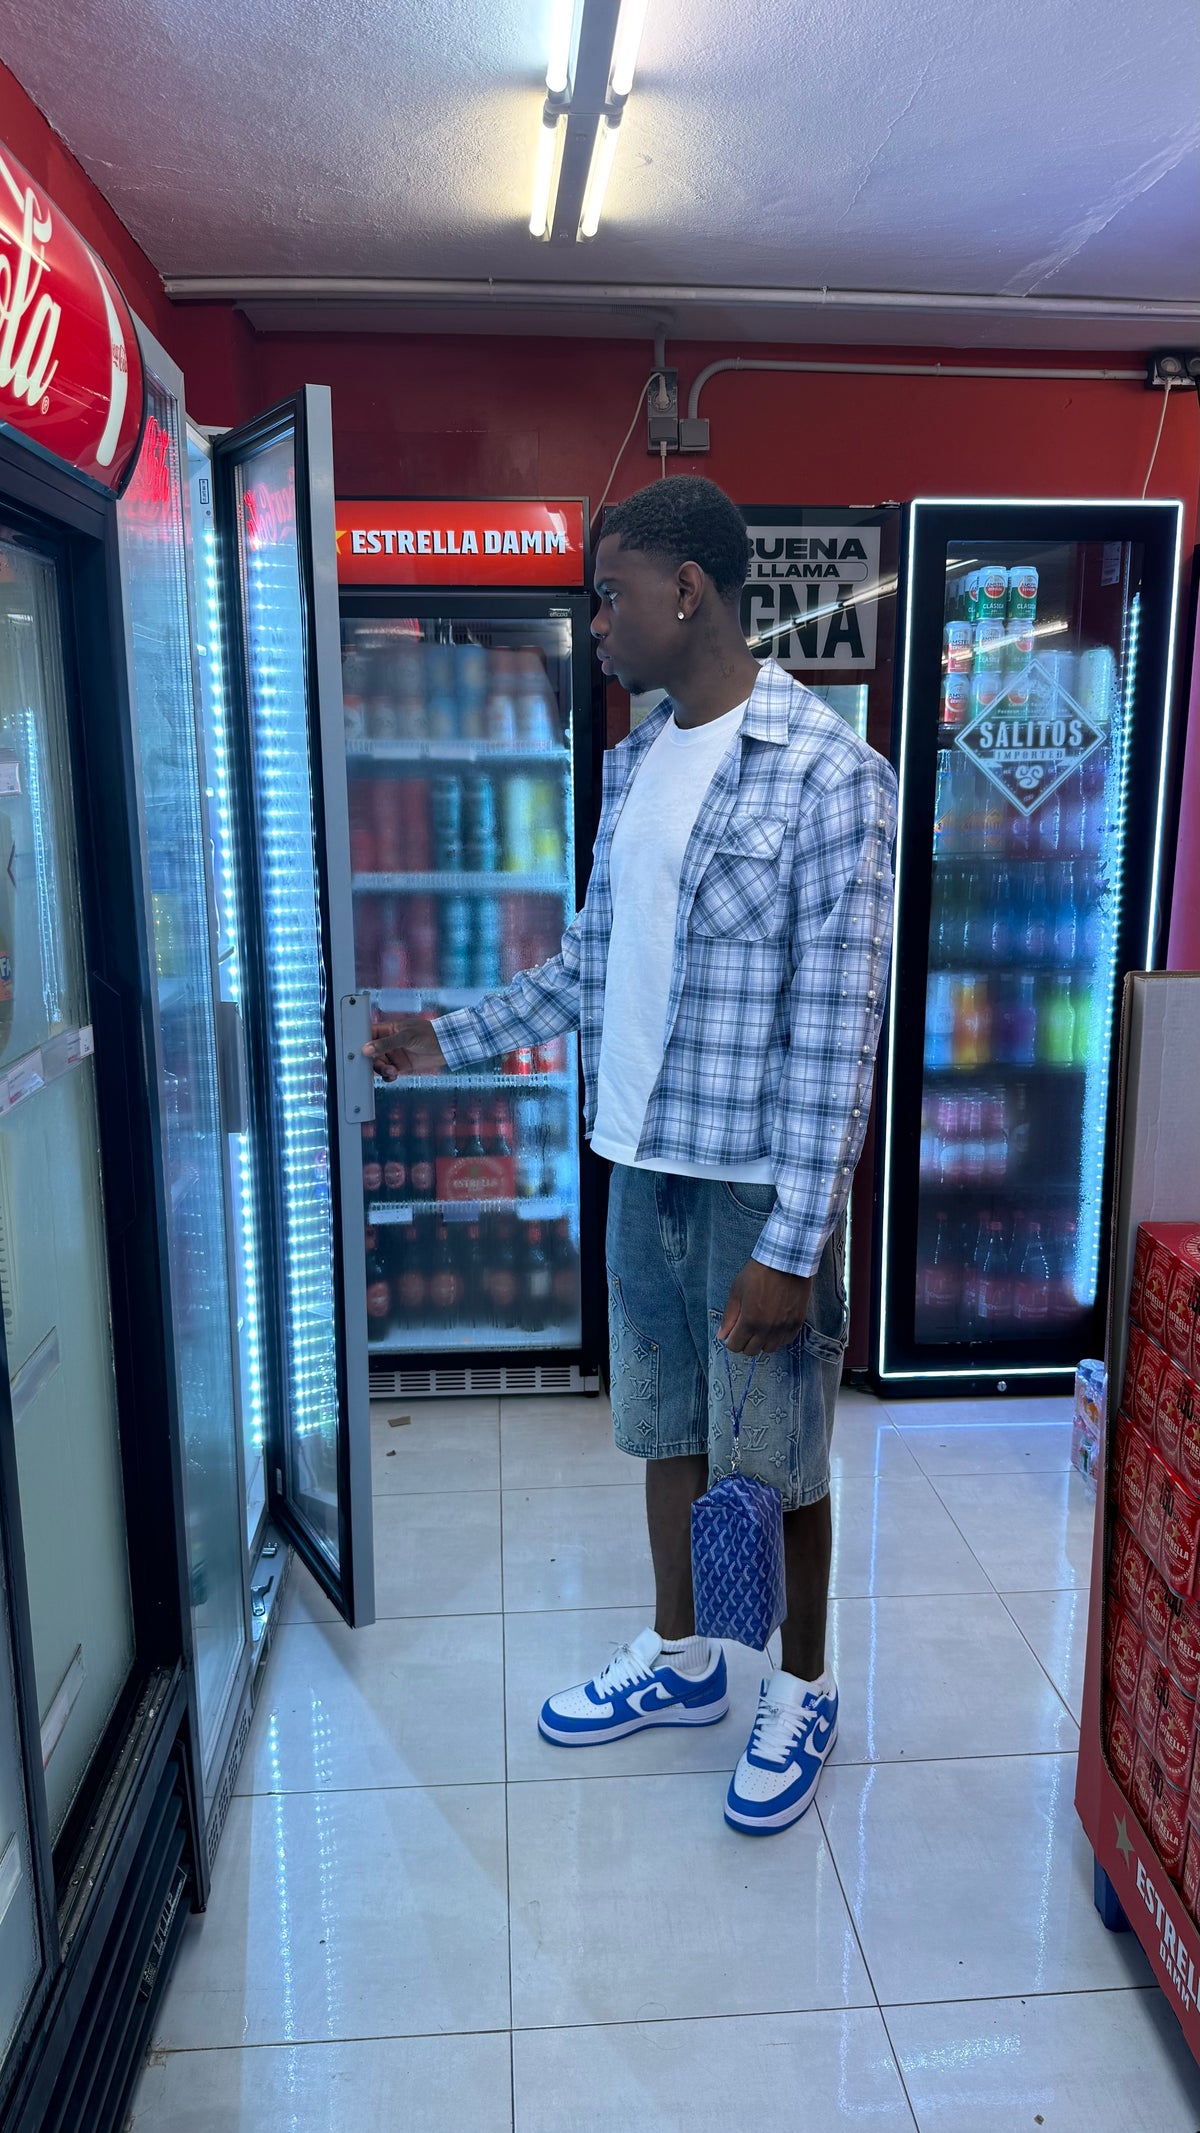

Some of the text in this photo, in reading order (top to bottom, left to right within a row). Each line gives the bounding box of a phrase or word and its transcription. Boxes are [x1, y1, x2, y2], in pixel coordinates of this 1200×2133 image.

[352, 530, 566, 555] ESTRELLA DAMM
[757, 563, 841, 578] LLAMA
[979, 720, 1083, 749] SALITOS
[996, 750, 1064, 760] IMPORTED
[1184, 1435, 1200, 1458] ESTRE
[1164, 1532, 1189, 1561] ESTRELLA
[1160, 1721, 1186, 1755] ESTRELLA
[1135, 1856, 1200, 2014] ESTREL
[1159, 1939, 1190, 2013] DAMM
